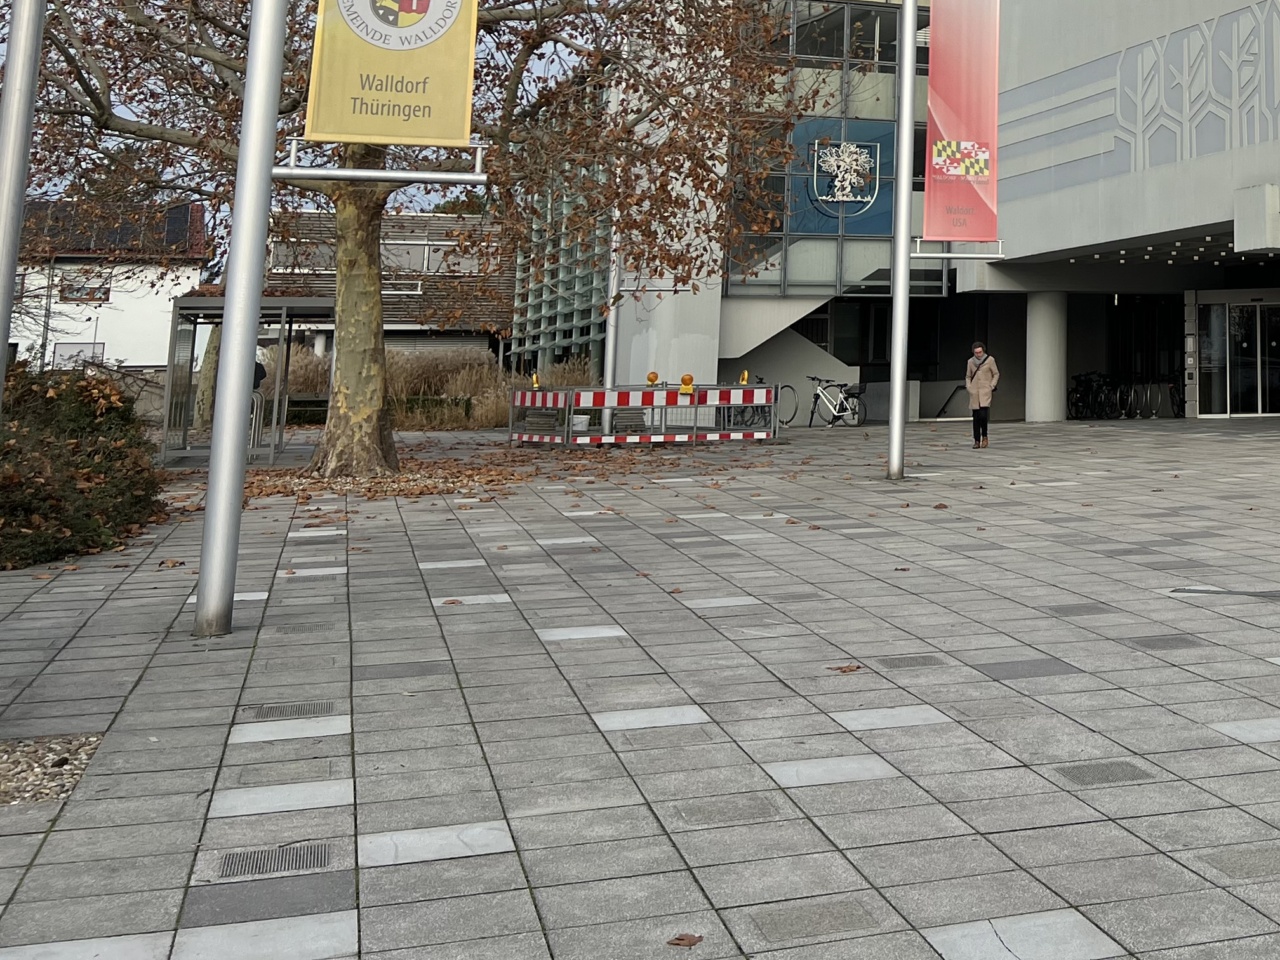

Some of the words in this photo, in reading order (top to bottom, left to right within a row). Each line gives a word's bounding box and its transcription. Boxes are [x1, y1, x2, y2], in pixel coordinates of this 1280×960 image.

[359, 73, 430, 94] Walldorf
[350, 96, 432, 122] Thüringen
[952, 217, 968, 228] USA
